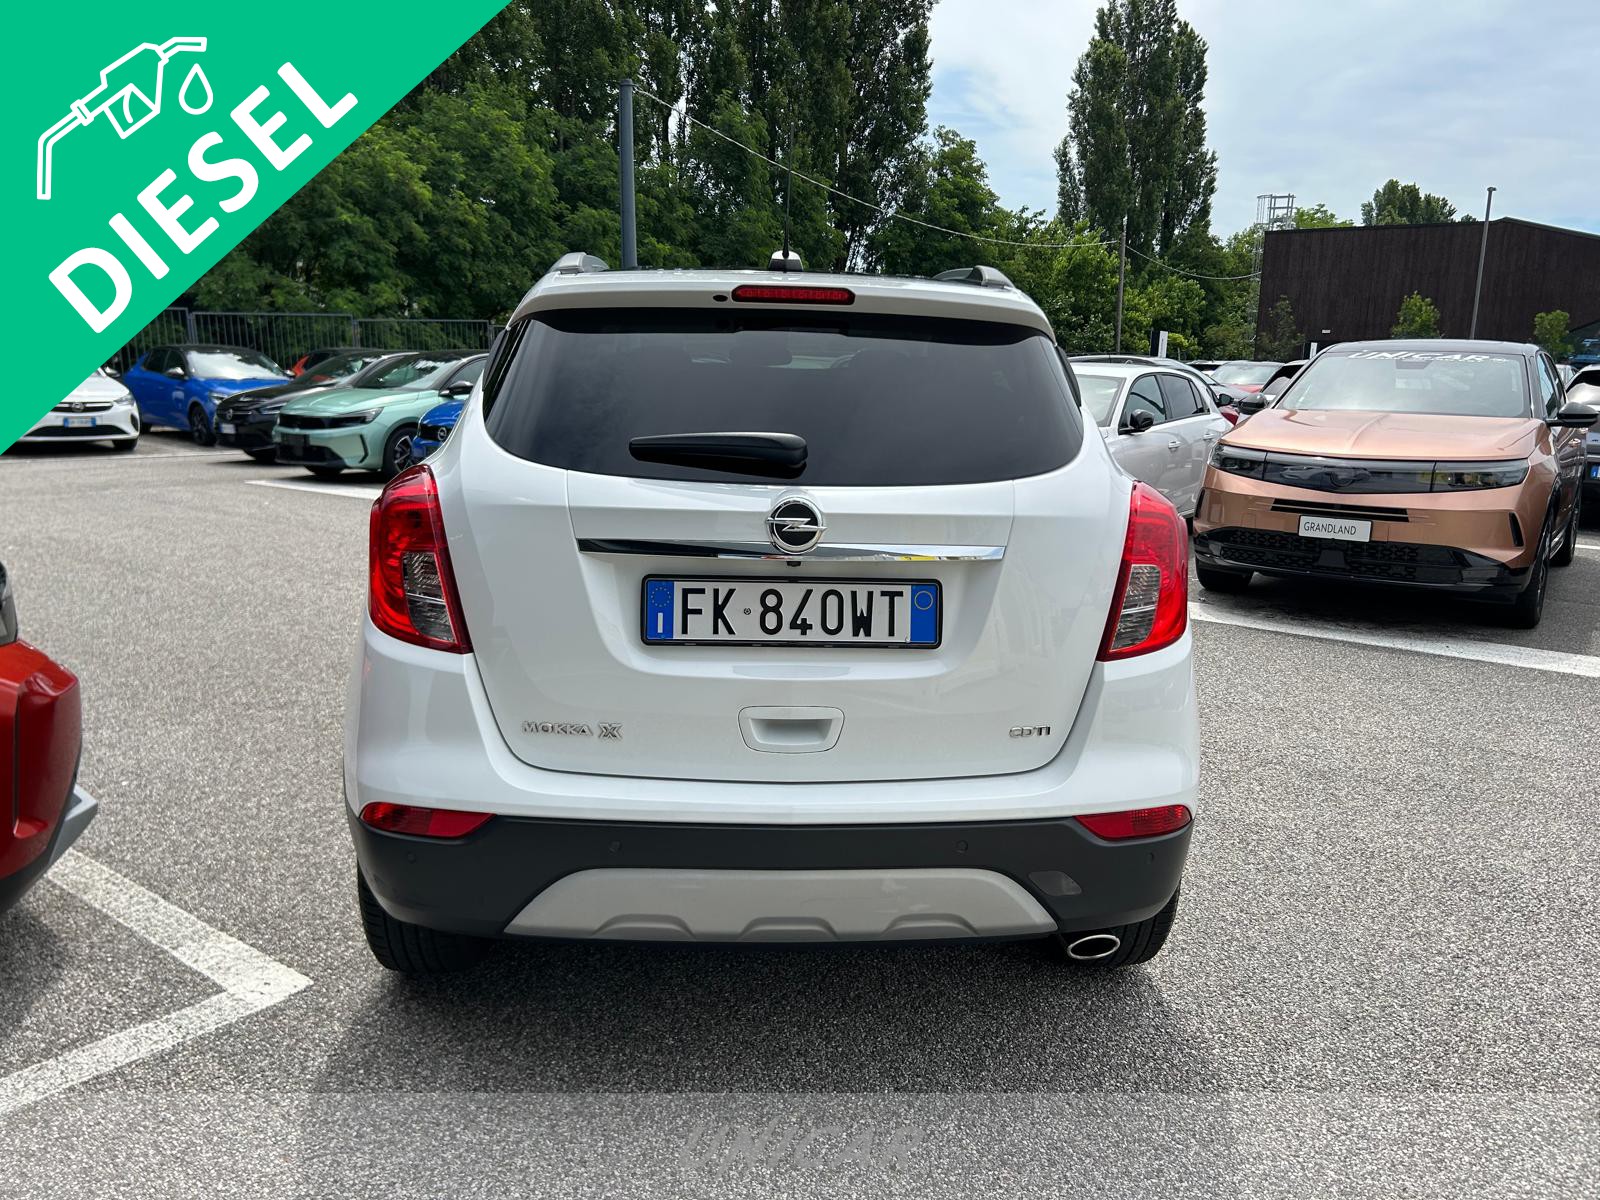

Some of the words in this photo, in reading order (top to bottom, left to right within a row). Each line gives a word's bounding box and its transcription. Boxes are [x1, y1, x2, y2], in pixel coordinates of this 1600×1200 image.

[1348, 351, 1490, 362] UNICAR
[1303, 521, 1356, 536] GRANDLAND
[680, 587, 736, 636] FK
[758, 588, 904, 637] 840WT
[522, 720, 593, 736] MOKKA
[599, 723, 622, 739] X
[1009, 726, 1051, 738] CDTI
